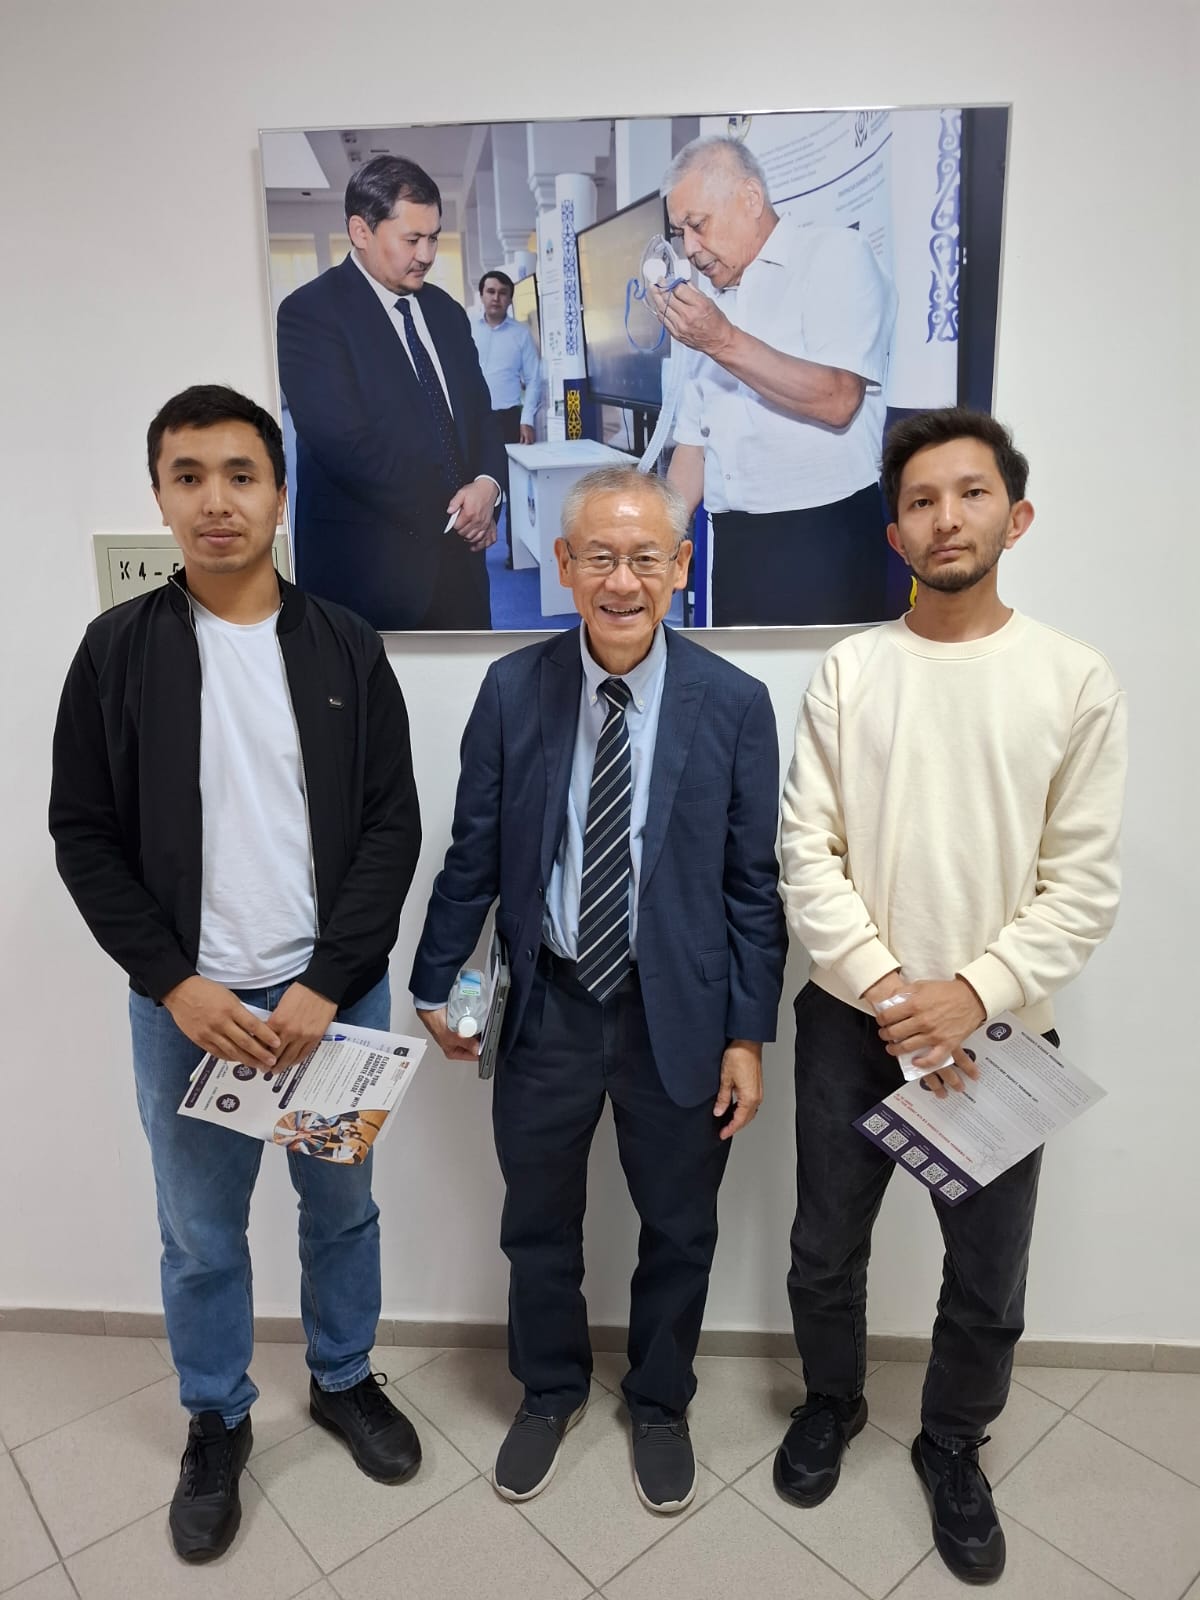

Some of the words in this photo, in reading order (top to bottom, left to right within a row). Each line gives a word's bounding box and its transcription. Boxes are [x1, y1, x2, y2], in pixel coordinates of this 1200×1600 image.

[360, 1052, 376, 1074] GRADUATE
[366, 1054, 383, 1077] ACADEMIC
[376, 1056, 390, 1074] ELEVATE
[350, 1074, 364, 1093] COLLEGE
[356, 1076, 370, 1096] JOURNEY
[369, 1074, 380, 1086] YOUR
